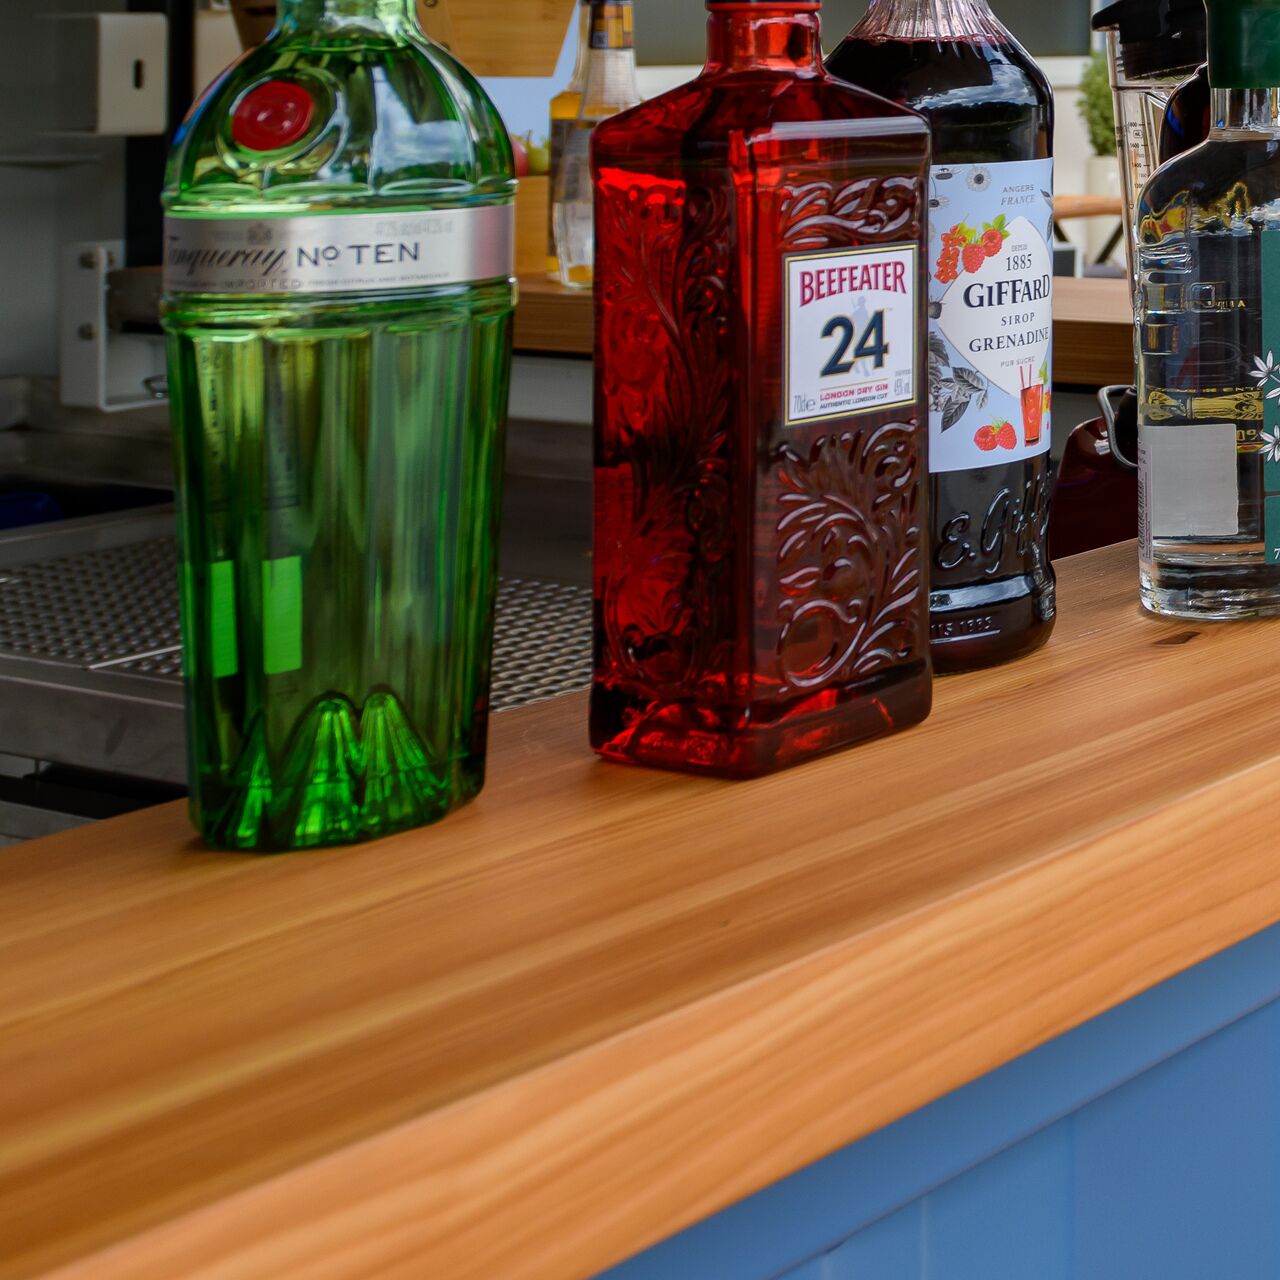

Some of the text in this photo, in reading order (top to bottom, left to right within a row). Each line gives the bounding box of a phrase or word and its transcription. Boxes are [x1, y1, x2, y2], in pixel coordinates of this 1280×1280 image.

[1002, 184, 1035, 193] ANGERS
[1000, 195, 1035, 206] FRANCE
[347, 241, 421, 265] TEN
[1005, 253, 1032, 271] 1885
[800, 261, 907, 307] BEEFEATER
[1000, 312, 1036, 326] SIROP
[820, 309, 889, 379] 24
[969, 326, 1049, 352] GRENADINE
[820, 389, 855, 402] LONDON
[874, 383, 889, 392] GIN
